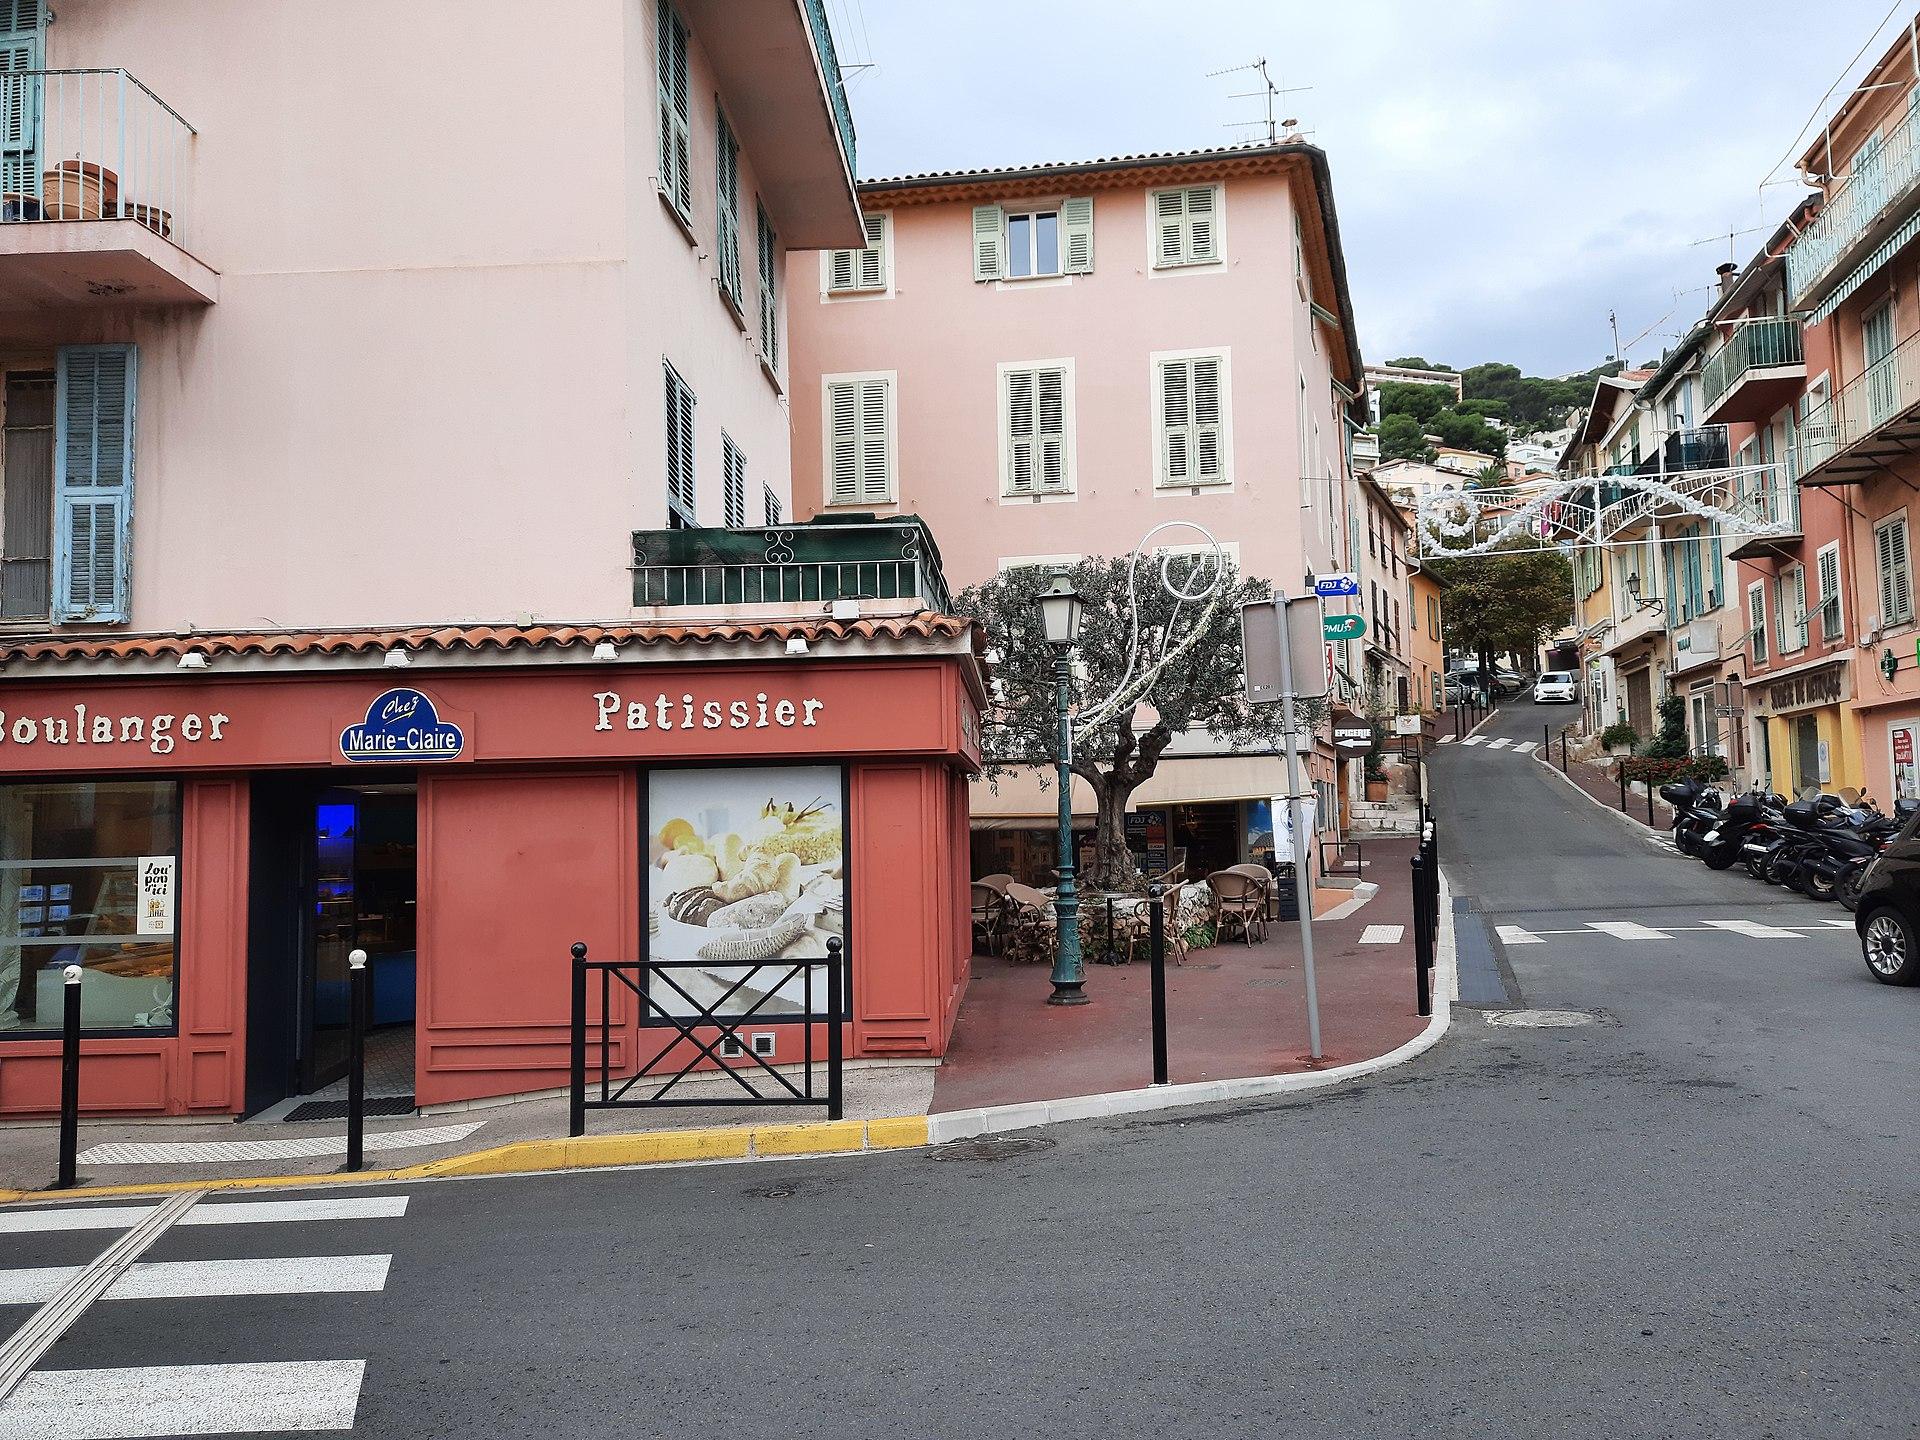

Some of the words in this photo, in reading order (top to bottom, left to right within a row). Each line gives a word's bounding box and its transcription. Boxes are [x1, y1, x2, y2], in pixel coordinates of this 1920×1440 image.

[1321, 581, 1338, 590] FDJ
[382, 695, 419, 719] Chez
[593, 691, 824, 730] Patissier
[0, 704, 229, 753] oulanger
[349, 728, 456, 750] Marie-Claire
[1334, 728, 1372, 739] EPICERIE
[1130, 816, 1146, 824] FDJ
